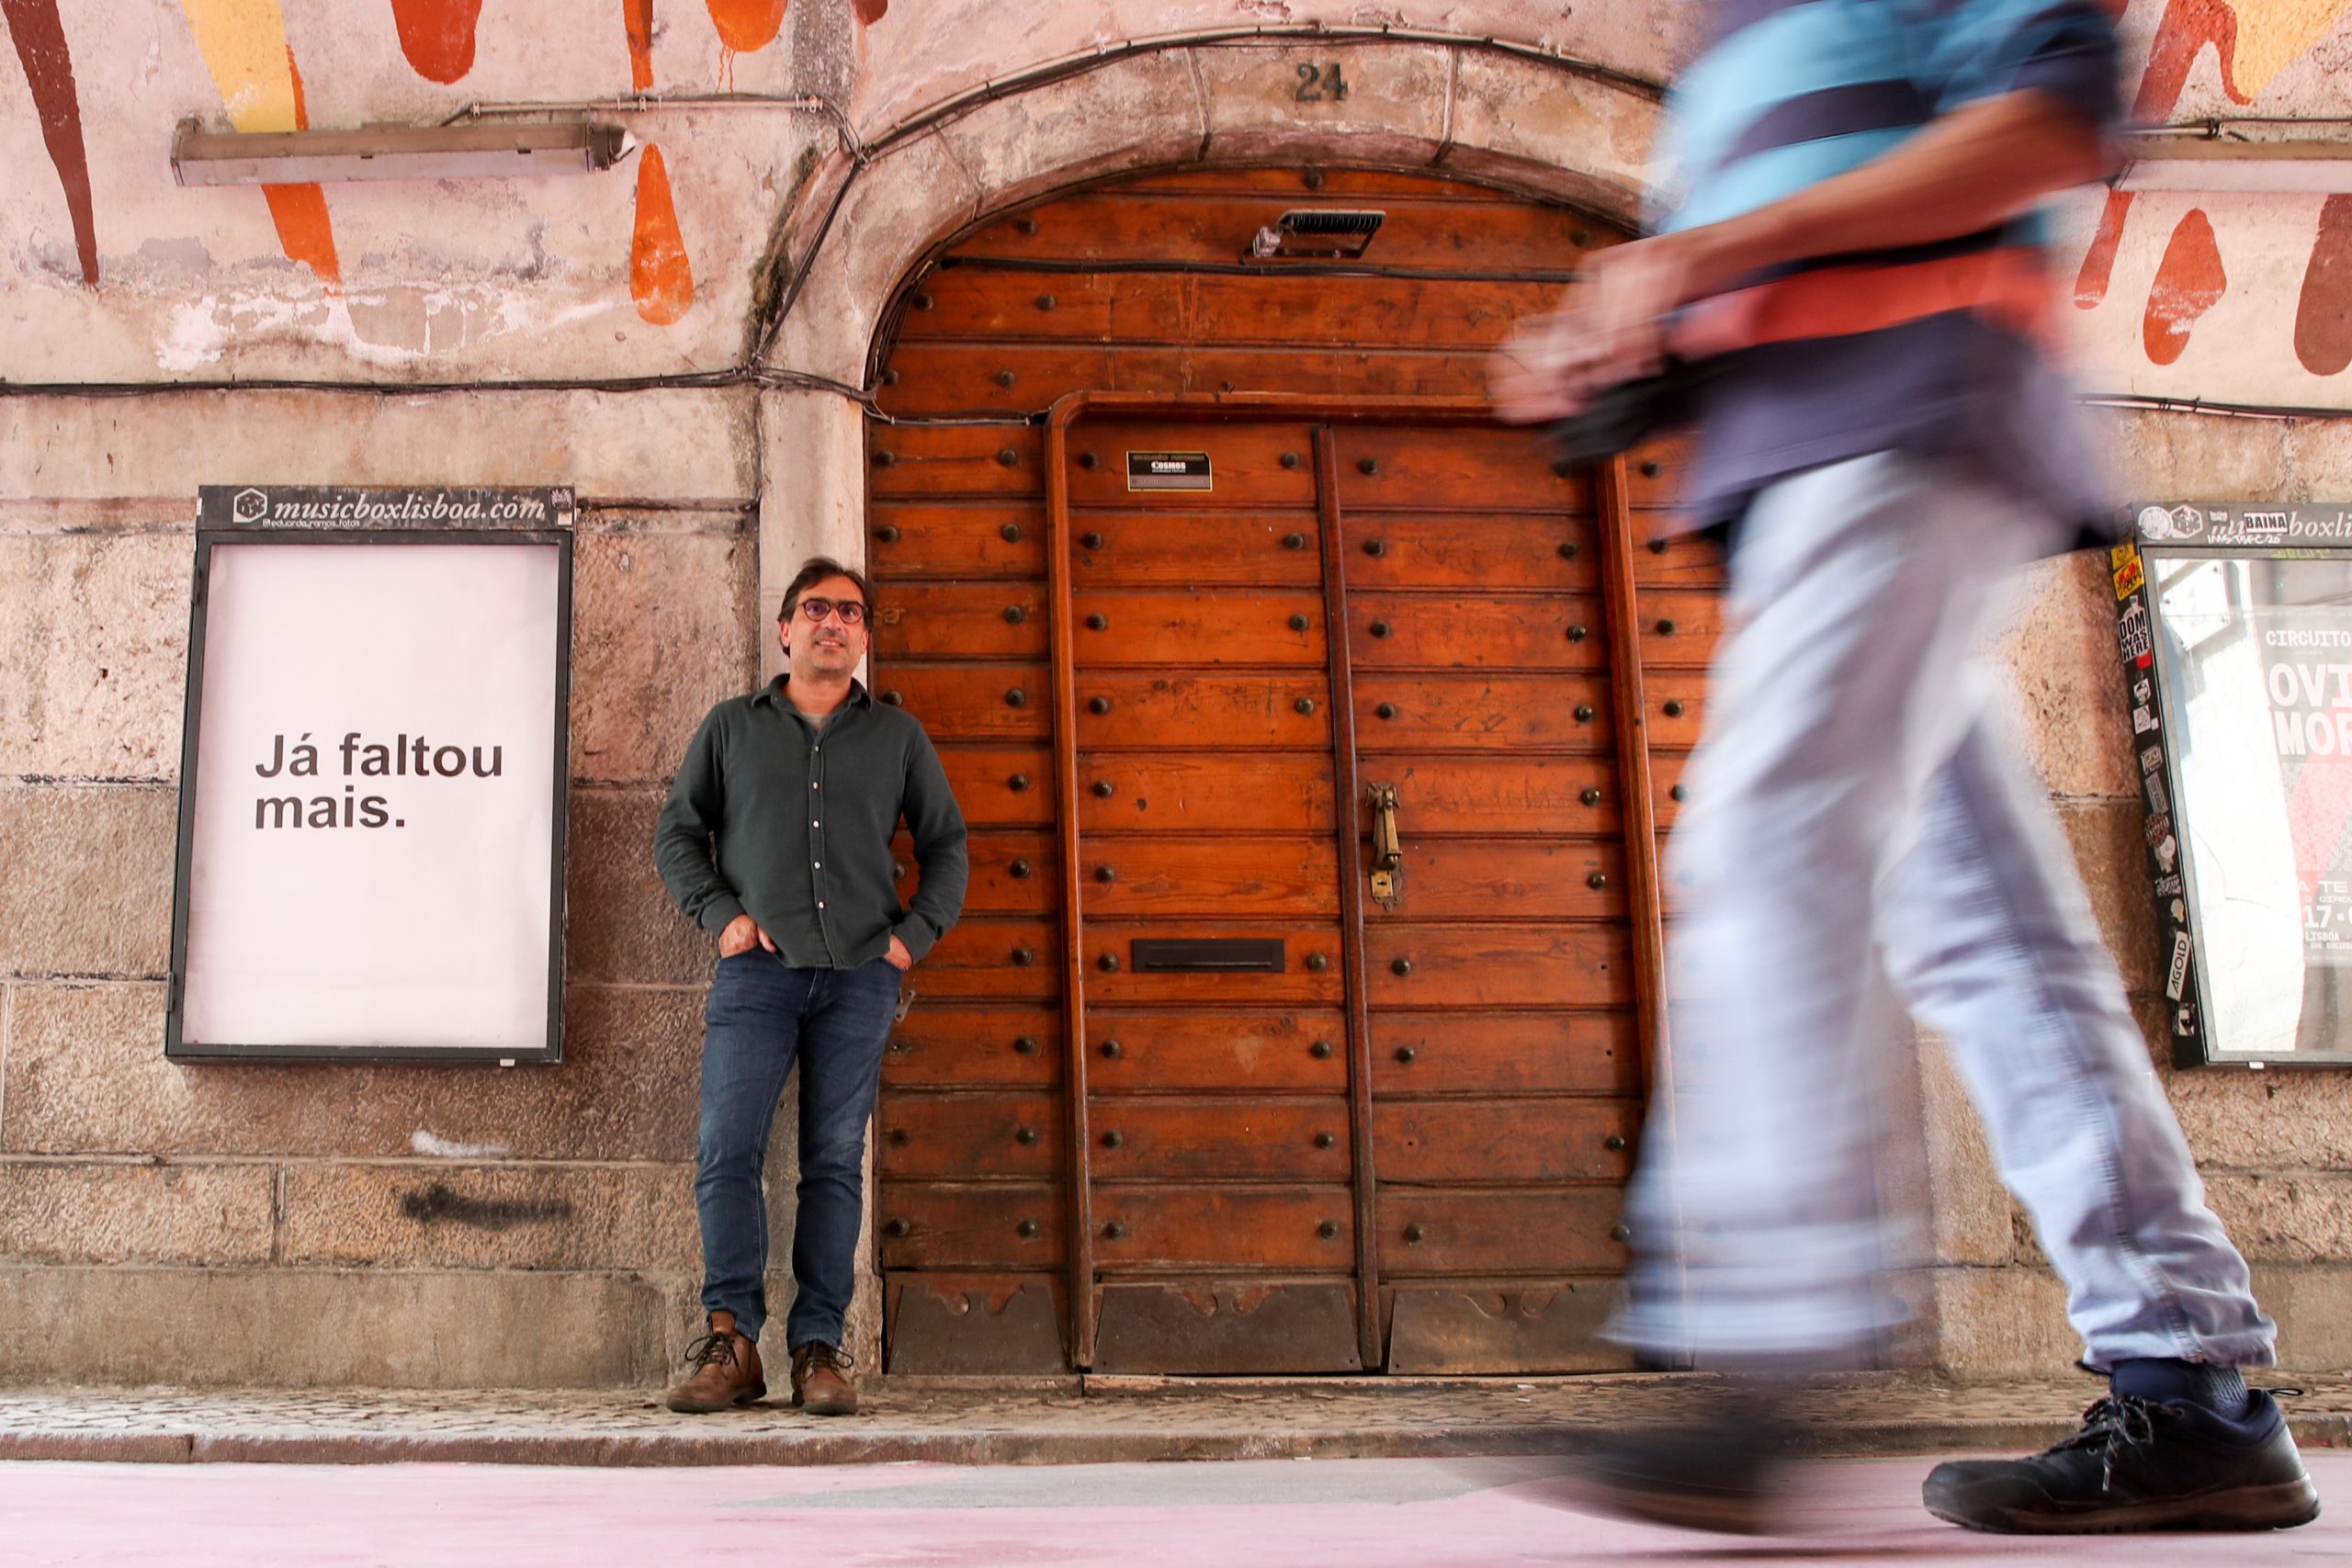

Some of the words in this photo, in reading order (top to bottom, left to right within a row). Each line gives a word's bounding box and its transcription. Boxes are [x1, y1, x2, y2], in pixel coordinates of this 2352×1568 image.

[1295, 62, 1349, 102] 24
[274, 493, 546, 521] musicboxlisboa.com
[2245, 515, 2287, 529] BAINA
[2120, 610, 2146, 639] DOM
[2121, 628, 2147, 649] WAS
[2265, 629, 2352, 648] CIRCUITO
[2123, 639, 2149, 661] HERE
[255, 732, 319, 778] Já
[339, 732, 503, 778] faltou
[255, 784, 405, 829] mais.
[2305, 931, 2341, 942] LISBOA
[2168, 939, 2188, 994] AGOLD
